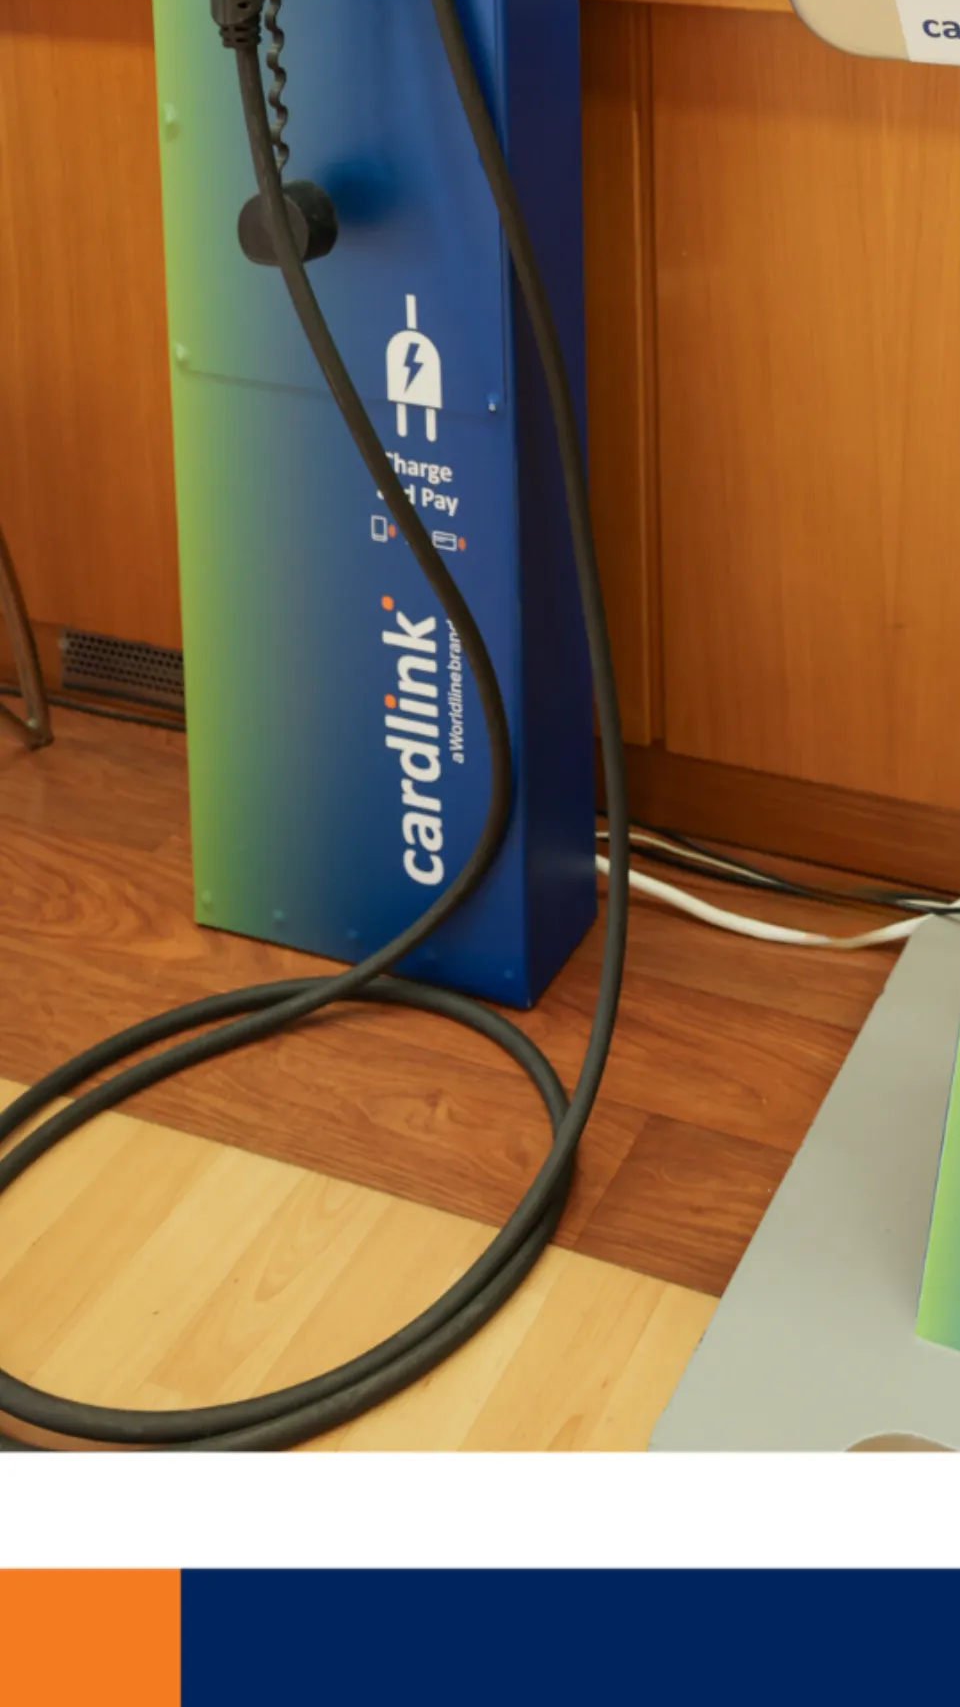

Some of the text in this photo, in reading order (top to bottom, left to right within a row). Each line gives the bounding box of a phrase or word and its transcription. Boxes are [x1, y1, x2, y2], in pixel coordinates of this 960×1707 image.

[385, 451, 453, 485] harge
[421, 487, 459, 517] Pay
[381, 611, 445, 886] cardlink
